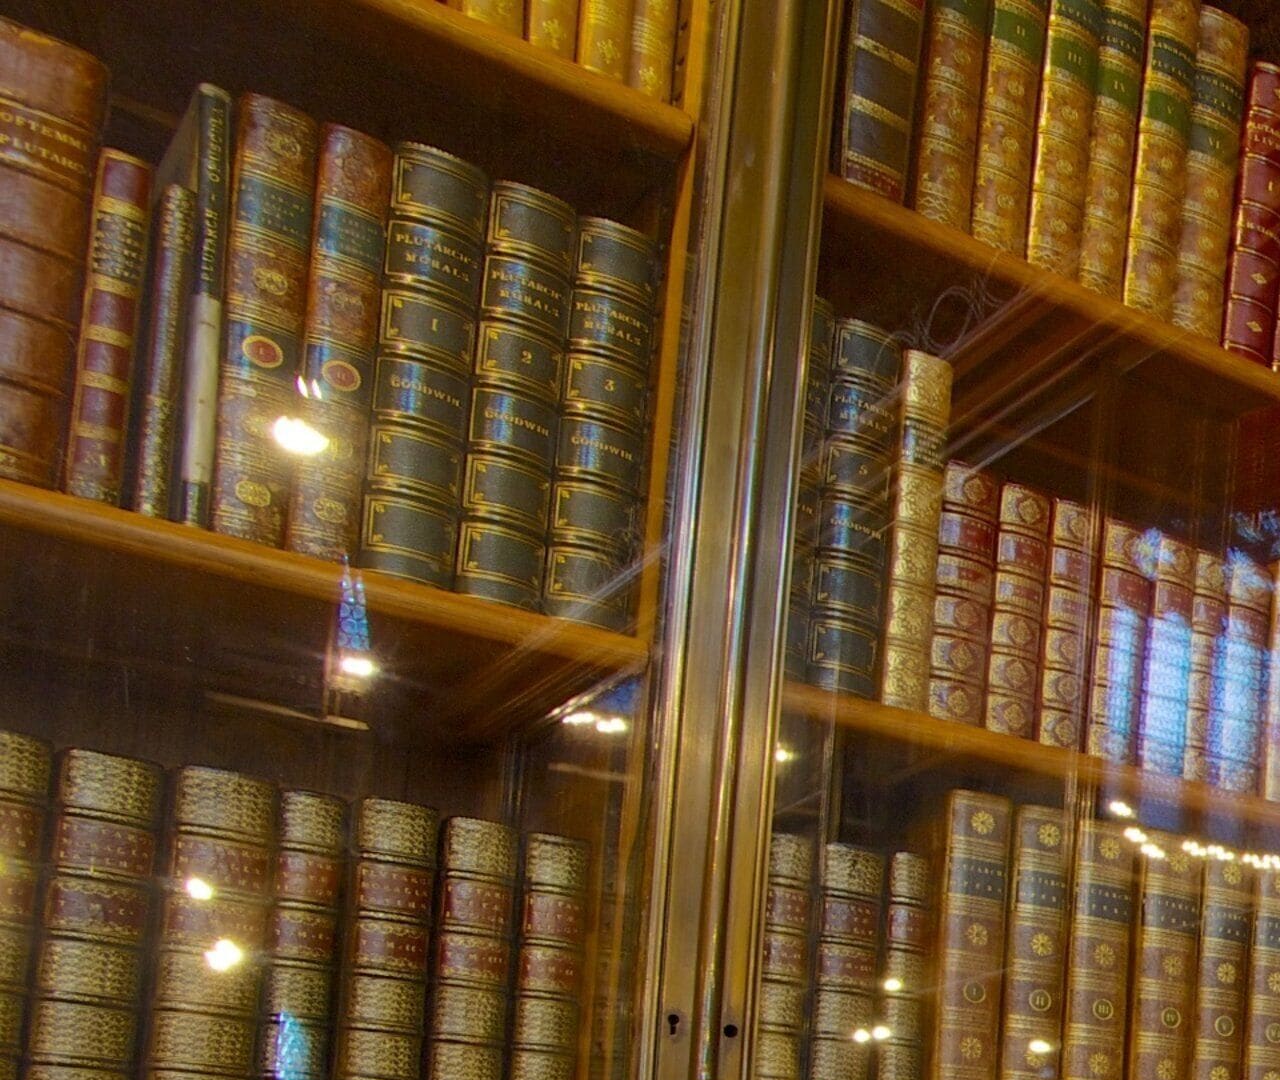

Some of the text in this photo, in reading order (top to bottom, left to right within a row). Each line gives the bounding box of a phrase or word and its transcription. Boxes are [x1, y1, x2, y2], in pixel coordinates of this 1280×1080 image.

[405, 253, 470, 282] MORALS
[500, 288, 559, 317] MORALS
[583, 320, 642, 346] MORALS
[390, 374, 461, 408] GOODWIN
[484, 407, 550, 438] GOODWIN
[571, 435, 634, 463] GOODWIN
